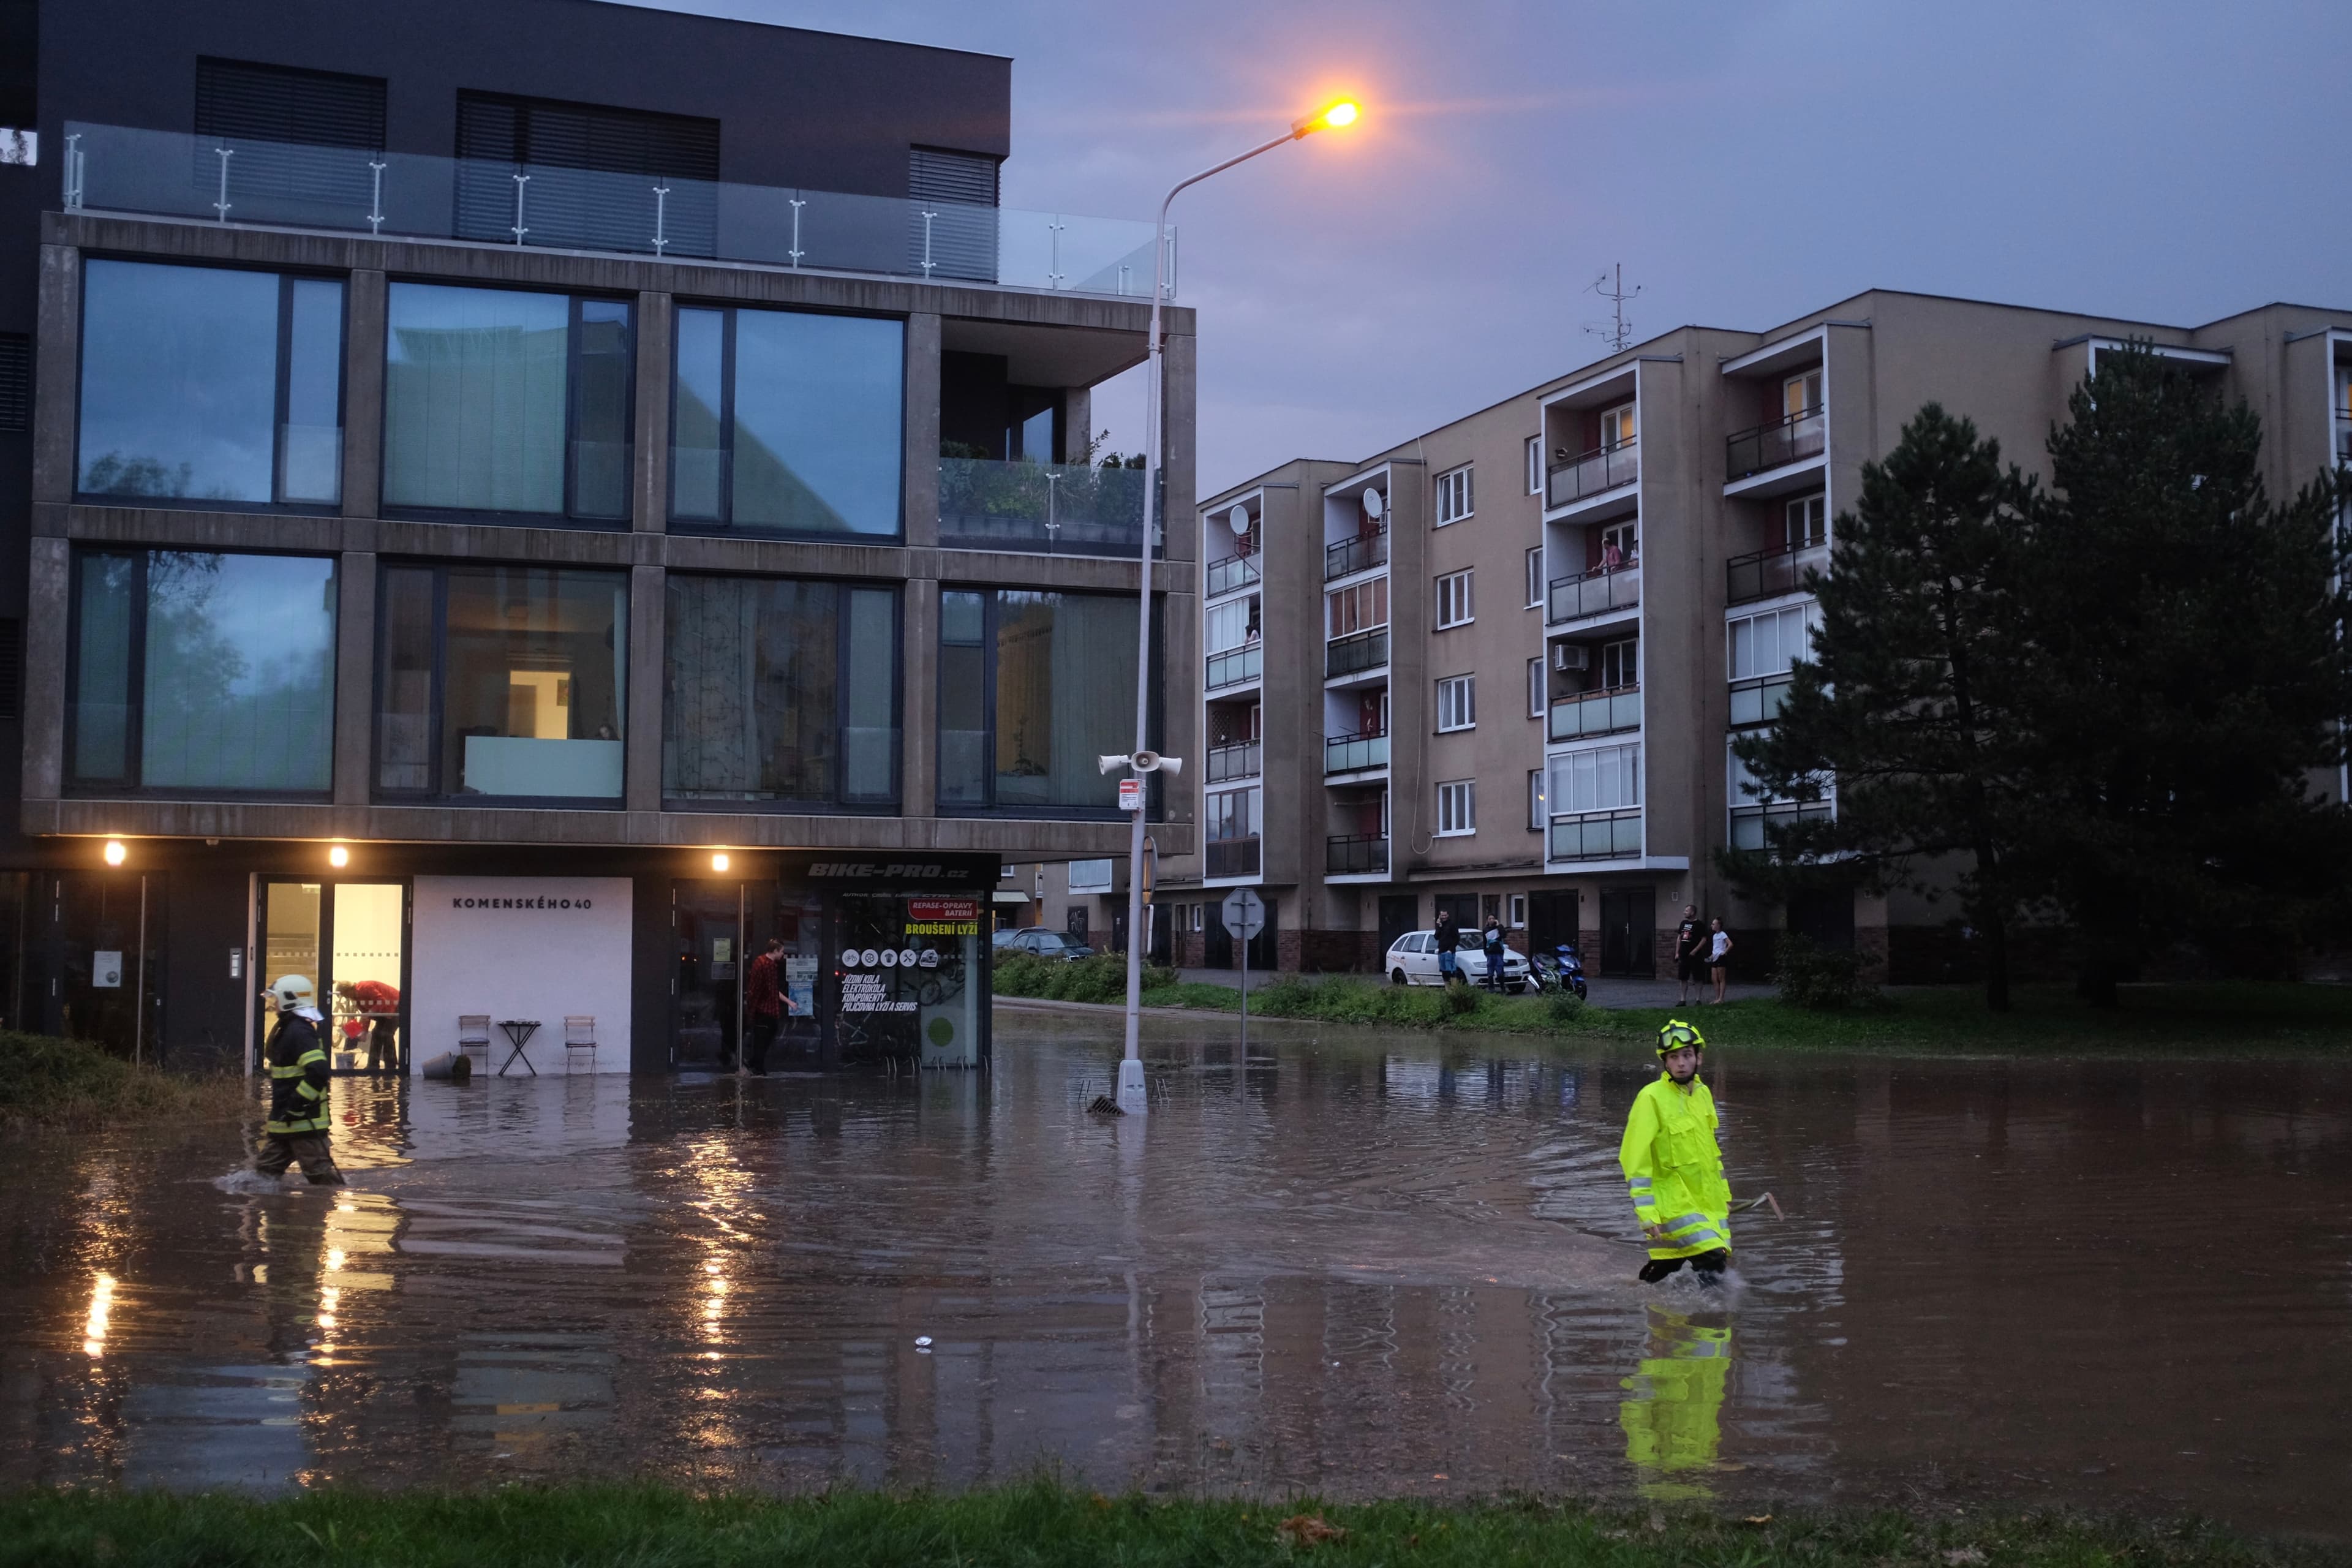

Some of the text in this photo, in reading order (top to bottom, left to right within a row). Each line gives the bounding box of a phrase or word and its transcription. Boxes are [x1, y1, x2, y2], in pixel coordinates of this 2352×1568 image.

[808, 863, 970, 878] BIKE-PRO.cz
[453, 895, 592, 910] KOMENSKÉHO 40
[905, 921, 978, 935] BROUŠENÍ LYŽÍ
[842, 973, 880, 984] JÍZDNÍ KOLA
[842, 984, 886, 993] ELEKTROKOLA
[842, 993, 886, 1002] KOMPONENTY
[888, 1002, 895, 1011] A
[894, 1001, 918, 1011] SERVIS
